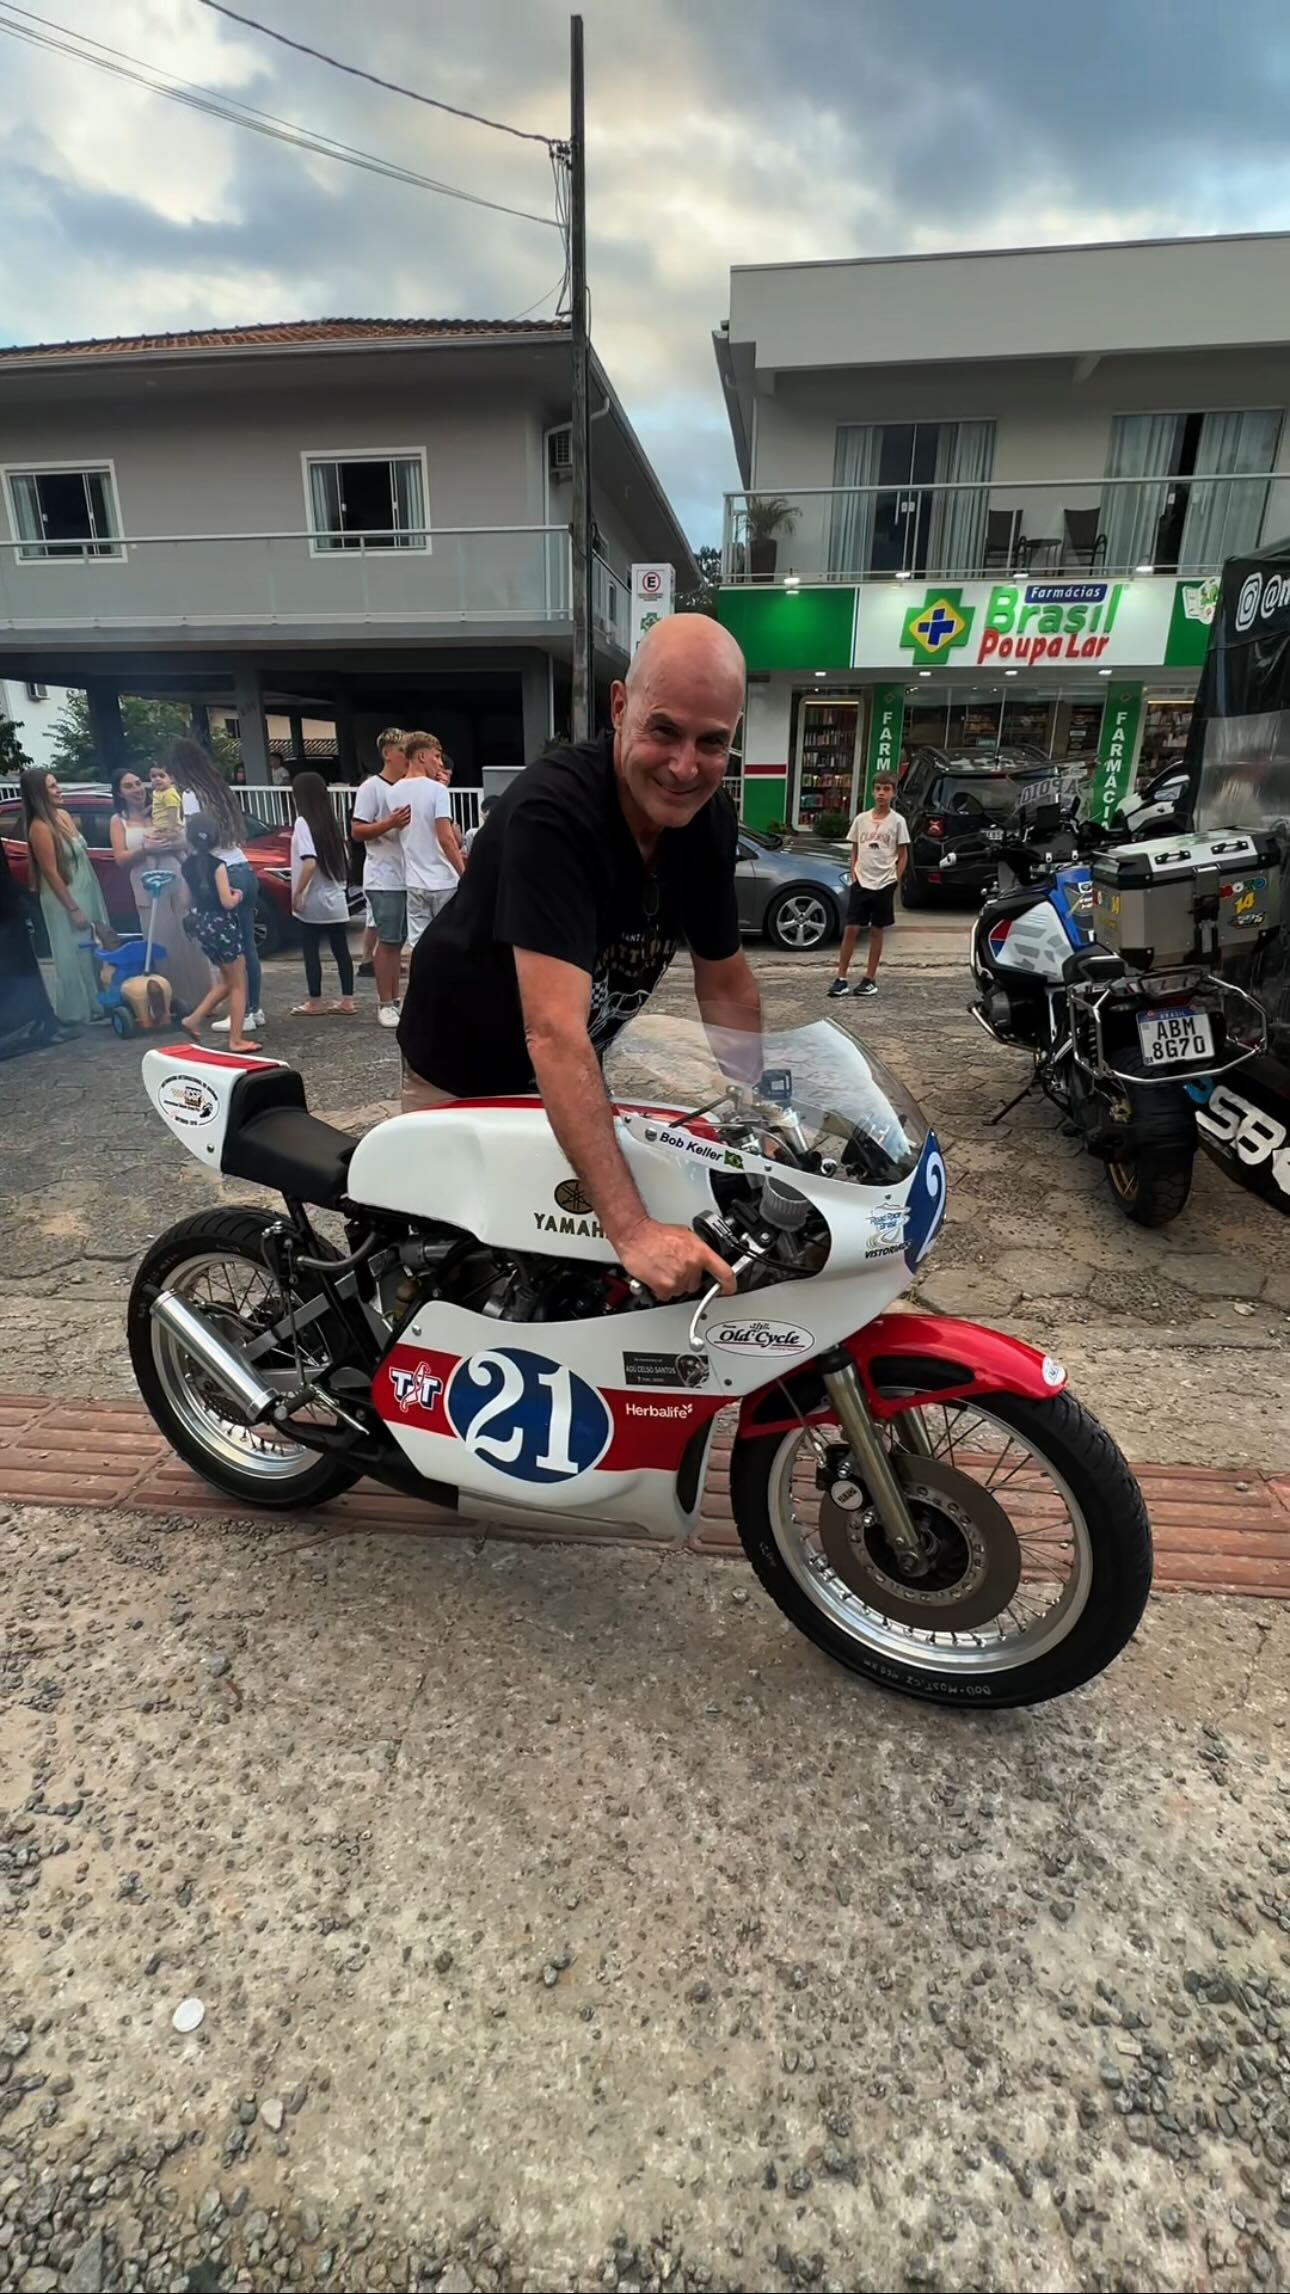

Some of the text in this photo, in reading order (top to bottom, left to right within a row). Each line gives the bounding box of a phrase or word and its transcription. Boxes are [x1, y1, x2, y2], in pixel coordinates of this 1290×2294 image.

[647, 576, 656, 588] E
[1031, 586, 1101, 599] Farmácias
[985, 583, 1123, 635] Brasil
[876, 711, 893, 771] FARM
[1157, 1017, 1196, 1040] ABM
[1152, 1035, 1206, 1060] 8G70
[660, 1132, 724, 1162] Bob Keller
[534, 1212, 608, 1239] YAMAH
[719, 1328, 800, 1348] Old Cycle
[464, 1351, 579, 1475] 21
[626, 1403, 688, 1419] Herbalife
